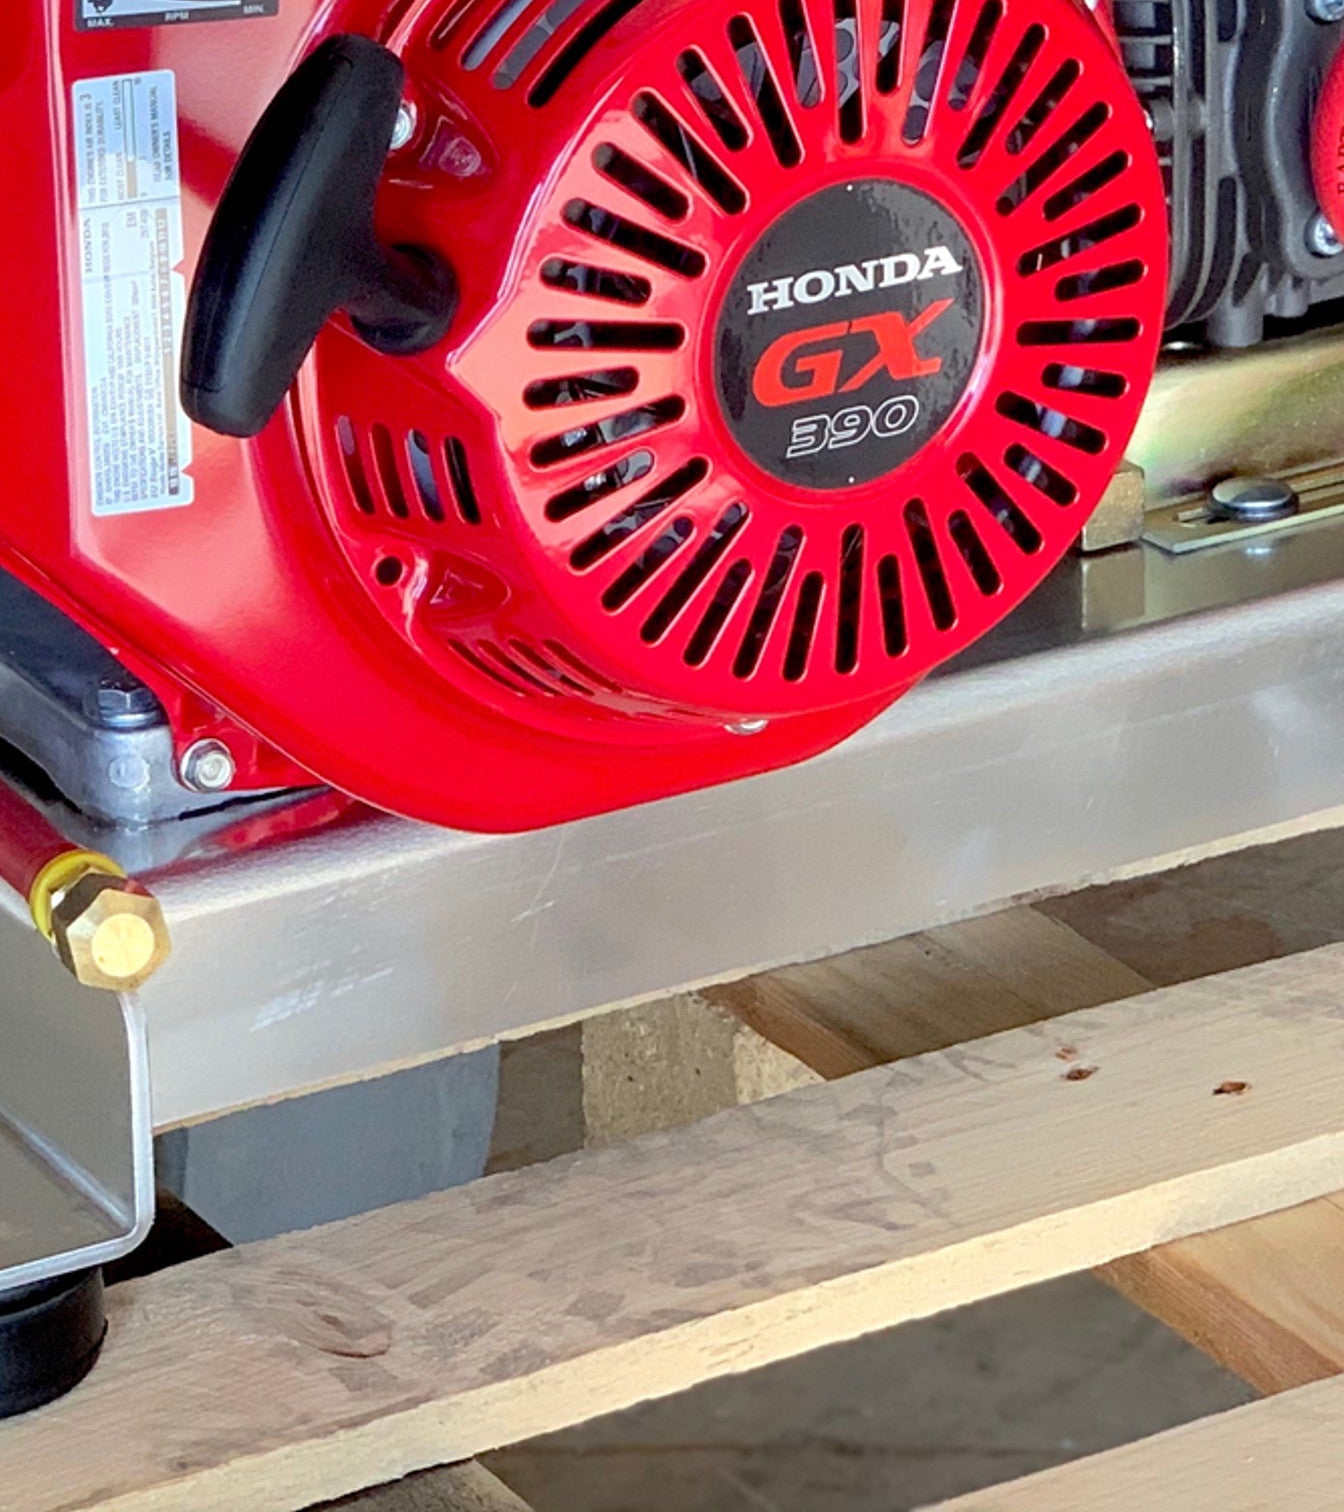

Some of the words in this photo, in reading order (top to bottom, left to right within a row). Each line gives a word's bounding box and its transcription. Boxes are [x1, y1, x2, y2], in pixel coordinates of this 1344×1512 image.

[164, 11, 190, 22] RPM
[79, 93, 92, 102] 3
[150, 86, 158, 121] MANUAL
[84, 113, 93, 135] INDEX
[83, 218, 92, 274] HONDA
[746, 244, 963, 316] HONDA
[752, 297, 956, 409] GX
[785, 394, 920, 459] 390
